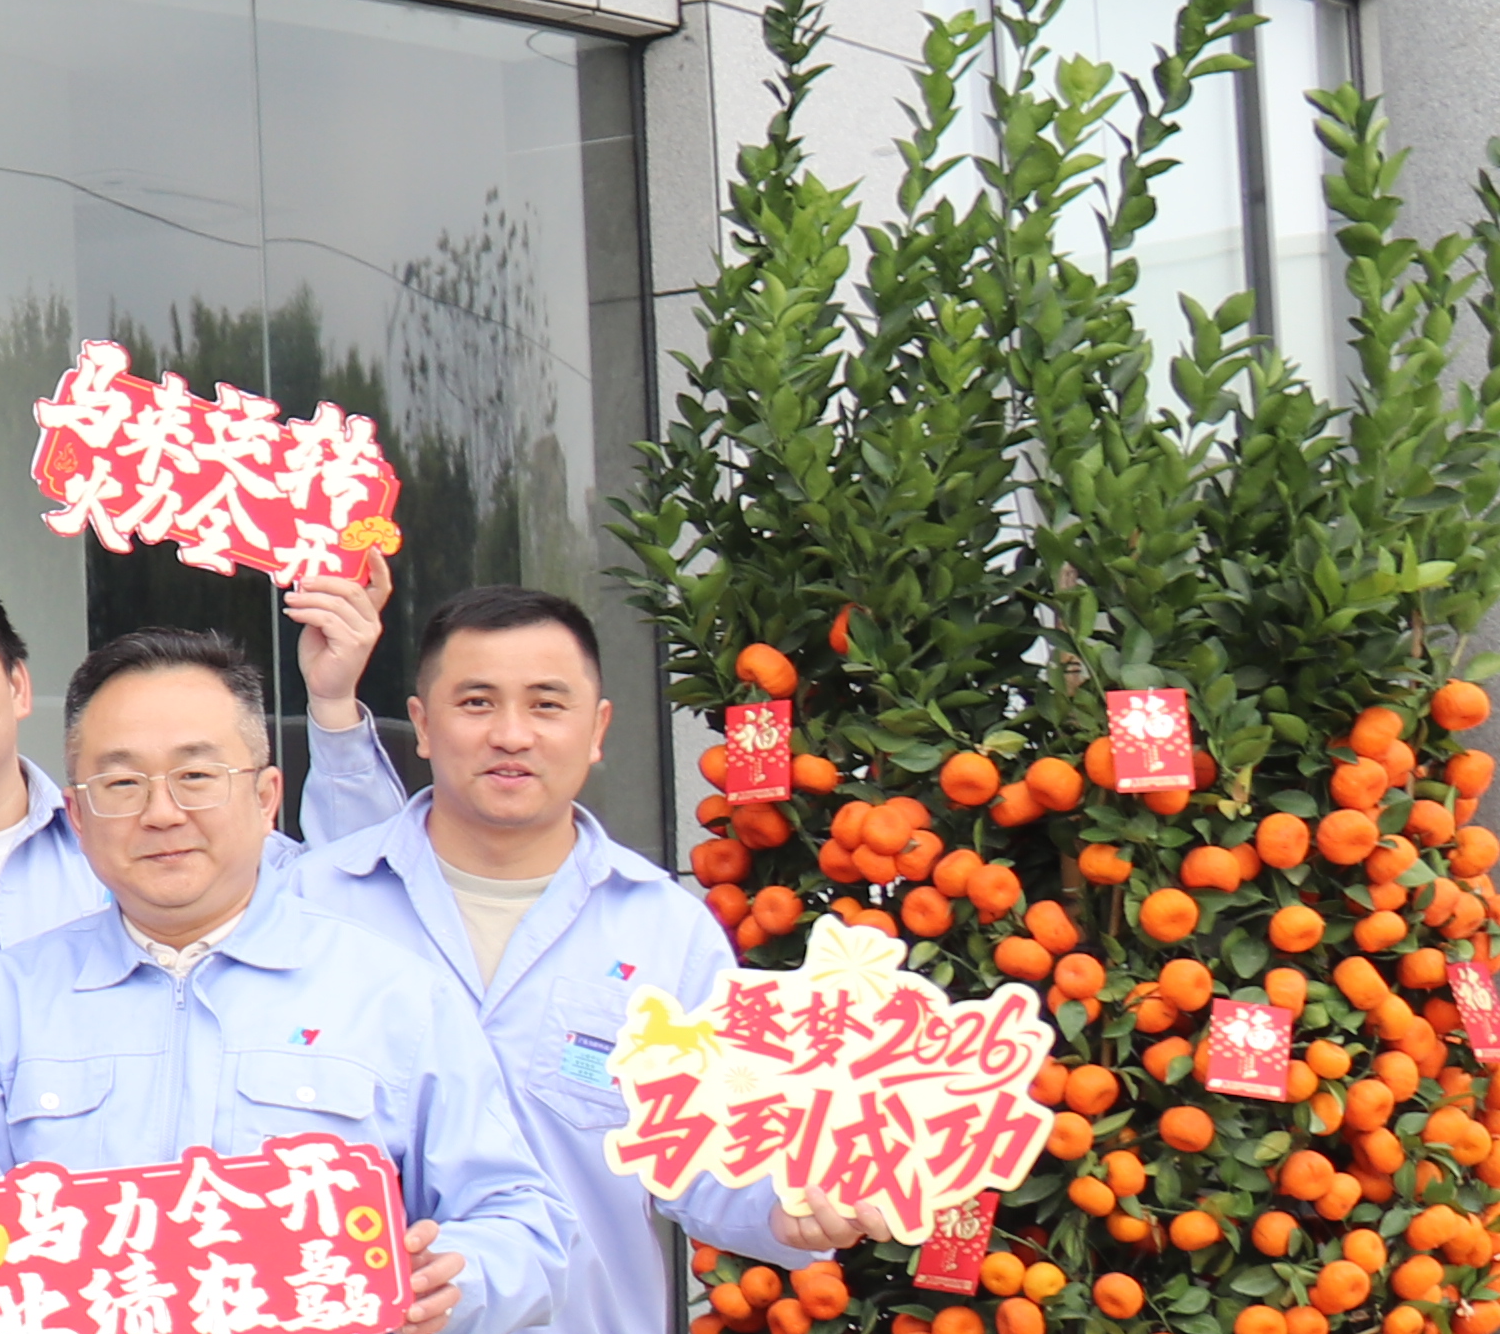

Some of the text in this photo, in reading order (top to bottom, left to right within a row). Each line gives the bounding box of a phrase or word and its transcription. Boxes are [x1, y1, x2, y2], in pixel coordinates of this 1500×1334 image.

[33, 339, 382, 530] 马来运转
[41, 455, 343, 588] 火力全开
[734, 708, 779, 754] 福
[1119, 695, 1175, 740] 福
[1456, 966, 1493, 1012] 福
[711, 980, 1038, 1087] 逐梦2026
[1222, 1008, 1277, 1052] 福
[616, 1071, 1043, 1233] 马到成功
[4, 1142, 361, 1264] 马力全开
[936, 1198, 981, 1240] 福
